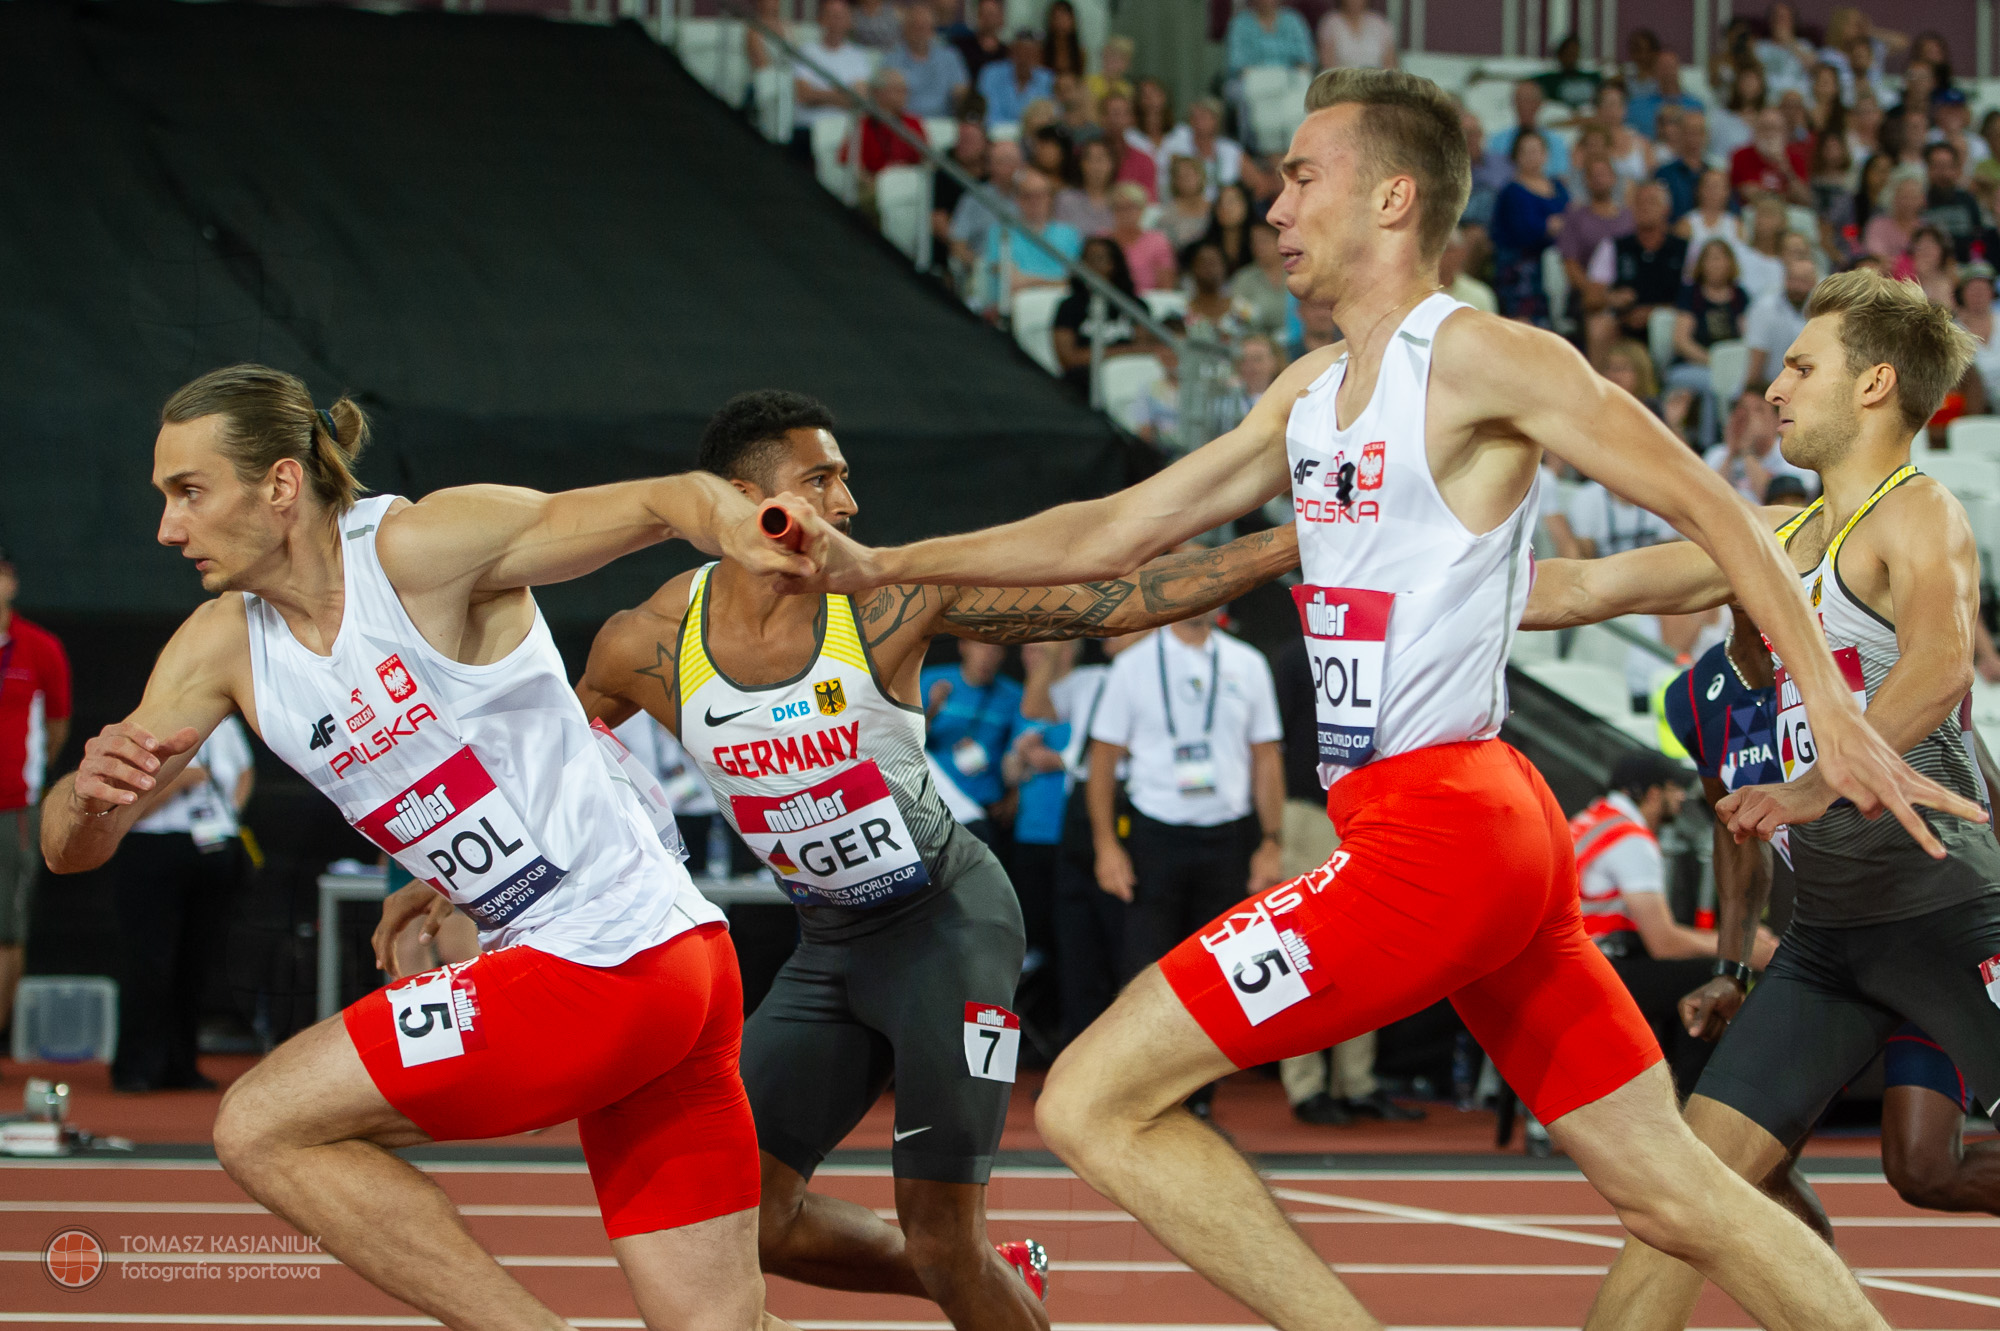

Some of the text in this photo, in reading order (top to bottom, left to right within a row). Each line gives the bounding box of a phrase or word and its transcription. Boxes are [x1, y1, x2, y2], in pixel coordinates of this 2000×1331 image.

[1296, 497, 1379, 523] POSKA
[1306, 590, 1349, 636] üller
[377, 656, 399, 673] POLSKA
[1314, 656, 1371, 708] POL
[349, 707, 374, 731] ORLEN
[771, 700, 811, 723] DKB
[329, 703, 438, 780] POLSKA
[712, 719, 860, 779] GERMANY
[1352, 734, 1370, 749] CUP
[1738, 743, 1773, 768] FRA
[384, 783, 457, 845] müller
[762, 788, 848, 833] müller
[427, 816, 524, 891] POL
[798, 817, 902, 878] GER
[494, 879, 530, 907] WORLD
[526, 864, 548, 884] CUP
[512, 887, 535, 906] 2018
[807, 866, 917, 900] ATHLETICS WORLD CUP
[830, 887, 893, 907] LONDON 2018
[1233, 948, 1291, 994] 5
[1279, 928, 1314, 974] müller
[398, 1002, 453, 1038] 5
[452, 988, 476, 1032] müller
[977, 1009, 1006, 1027] müller
[979, 1028, 1001, 1075] 7
